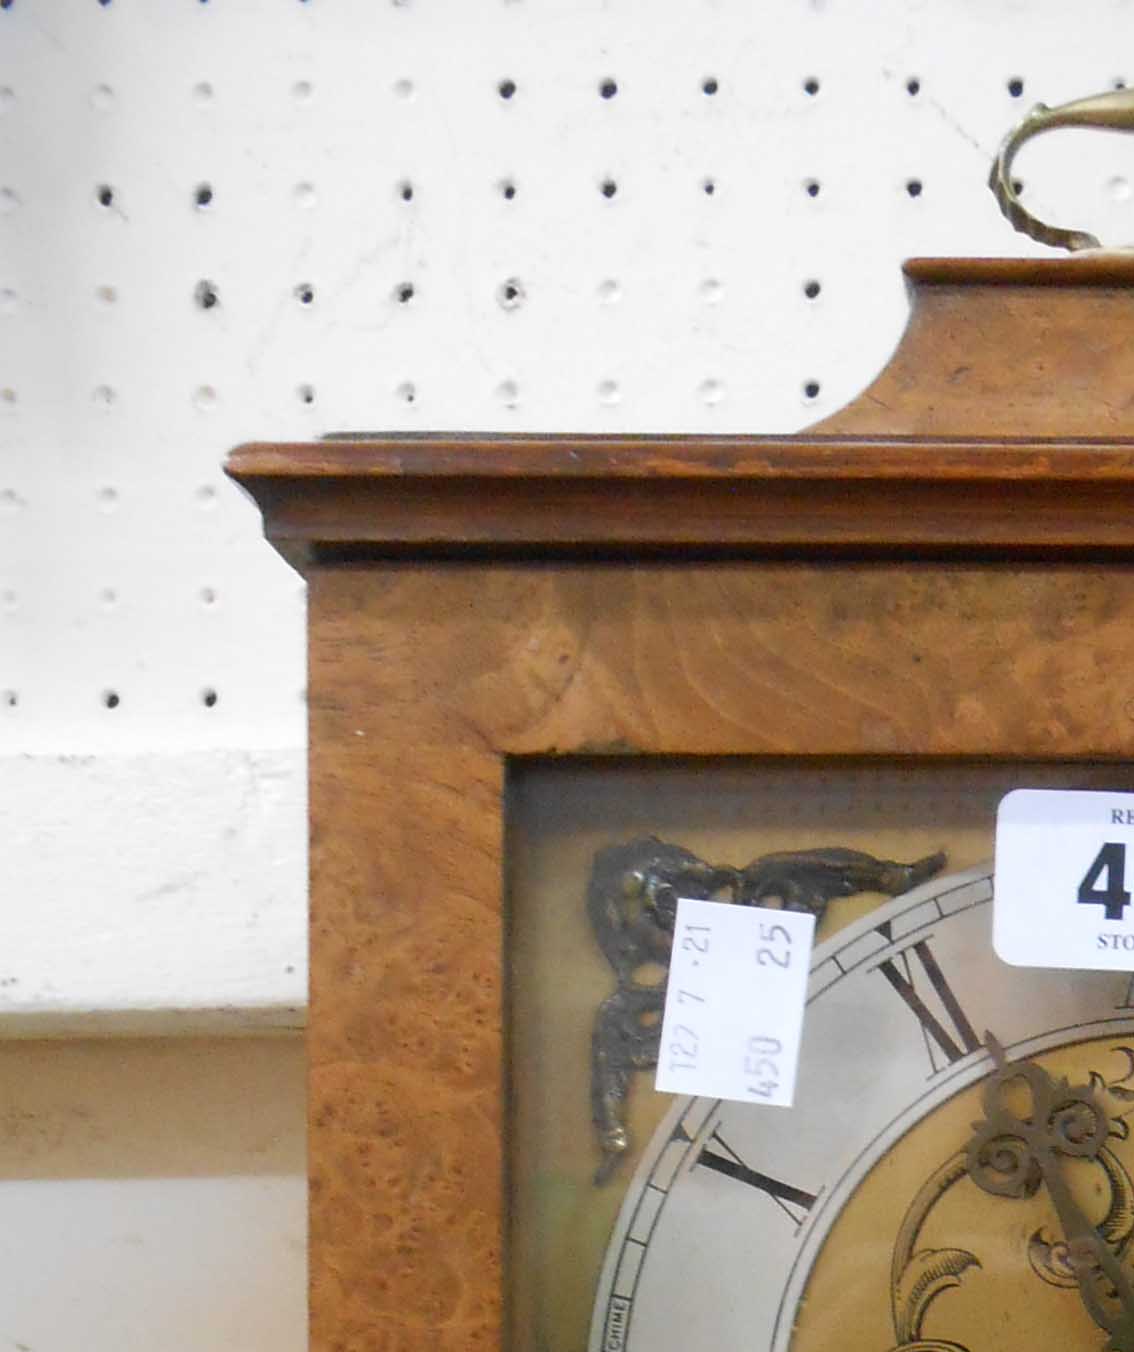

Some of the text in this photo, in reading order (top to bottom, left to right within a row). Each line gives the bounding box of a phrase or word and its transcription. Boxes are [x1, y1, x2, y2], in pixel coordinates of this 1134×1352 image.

[744, 923, 793, 1098] 450 25
[866, 933, 985, 1081] XI
[689, 1121, 826, 1238] X
[607, 1303, 628, 1351] CHIME
